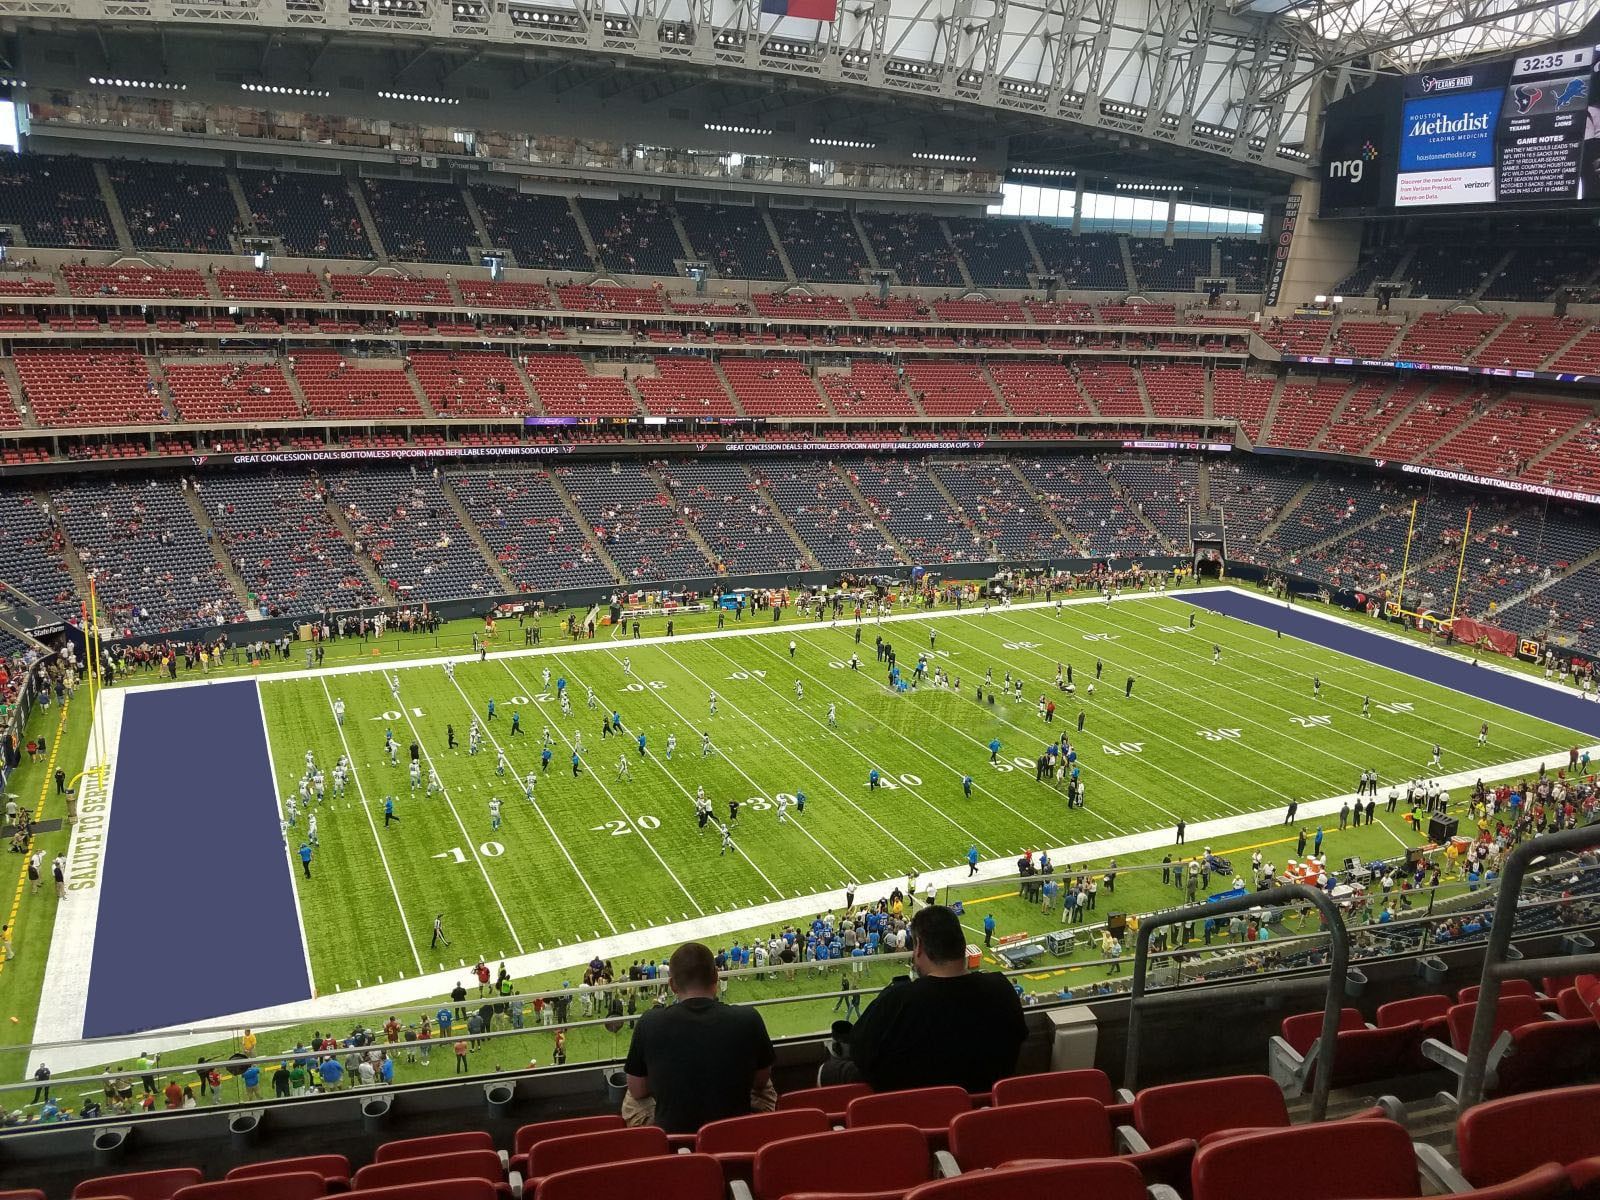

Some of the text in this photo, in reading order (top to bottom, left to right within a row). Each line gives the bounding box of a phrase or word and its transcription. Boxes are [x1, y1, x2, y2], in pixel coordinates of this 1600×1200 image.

[1523, 55, 1563, 71] 32:35
[1435, 77, 1473, 89] TEXANS RADIO
[1410, 113, 1441, 121] HOUSTON
[1408, 112, 1489, 137] Methodist
[1457, 133, 1488, 141] MEDICINE
[1516, 135, 1564, 145] GAME NOTES
[1416, 150, 1477, 161] houstonmethodist.org
[1330, 159, 1363, 183] nrg
[1463, 180, 1490, 189] verizon
[744, 443, 782, 451] CONCESSION
[782, 443, 803, 451] DEALS:
[803, 442, 840, 450] BOTTOMLESS
[840, 442, 867, 450] POPCORN
[867, 442, 880, 450] AND
[233, 455, 260, 464] GREAT
[260, 453, 312, 463] CONCESSION
[313, 452, 340, 461] DEALS:
[340, 450, 391, 460] BOTTOMLESS
[391, 449, 428, 458] POPCORN
[428, 449, 446, 458] AND
[446, 448, 485, 456] REFILLABLE
[485, 447, 520, 456] SOUVENIR
[521, 447, 540, 455] SODA
[1402, 464, 1420, 475] GREAT
[1420, 467, 1459, 481] CONCESSION
[1458, 473, 1480, 484] DEALS:
[1480, 476, 1522, 491] BOTTOMLESS
[1522, 484, 1556, 496] POPCORN
[1556, 489, 1573, 499] AND
[1522, 641, 1537, 655] 25
[730, 669, 768, 681] 40
[626, 680, 668, 692] 30
[510, 692, 556, 706] 20
[381, 706, 428, 721] 10
[1289, 715, 1331, 728] 20
[1196, 728, 1240, 742] 30
[1102, 742, 1143, 756] 40
[988, 757, 1036, 773] 50
[878, 773, 923, 790] 40
[78, 815, 104, 833] TO
[602, 815, 662, 837] 20
[448, 841, 505, 864] 10
[68, 834, 102, 891] SALUTE
